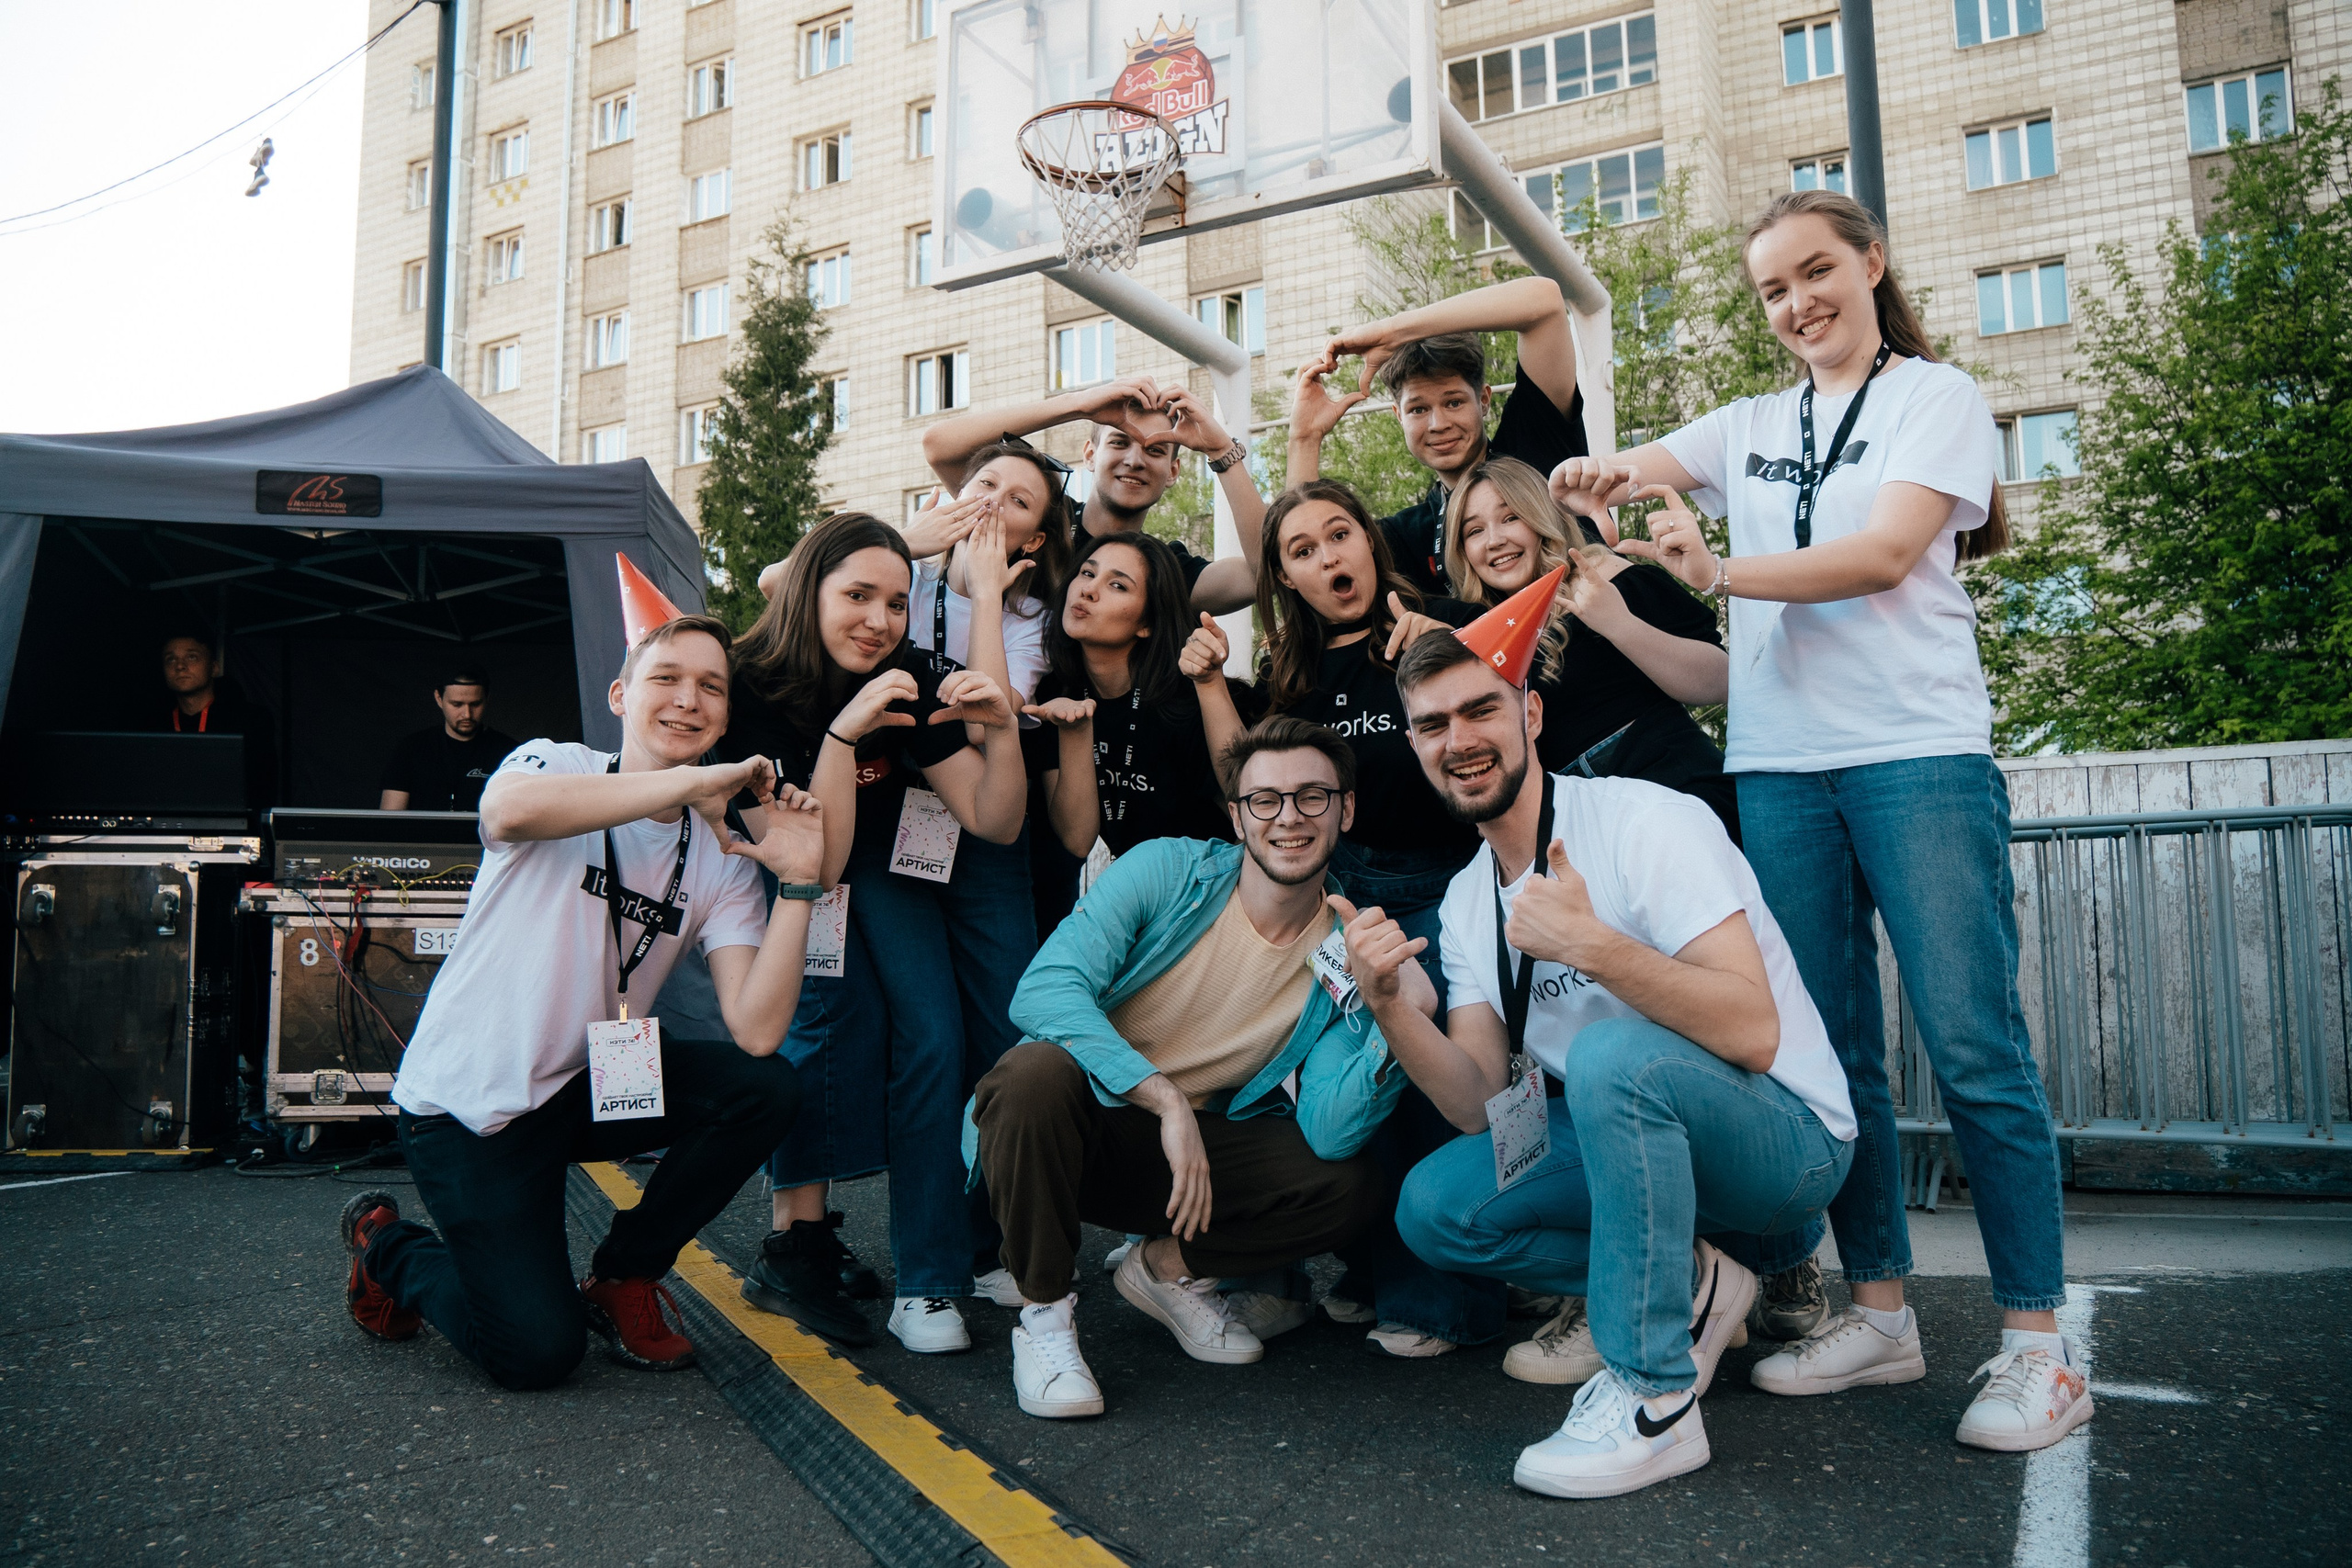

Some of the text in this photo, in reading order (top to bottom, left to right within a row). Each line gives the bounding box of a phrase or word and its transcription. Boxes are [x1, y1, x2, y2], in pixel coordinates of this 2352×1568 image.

[1161, 79, 1208, 116] Bull
[1096, 102, 1227, 173] REIGN
[1802, 397, 1810, 417] NETI
[1757, 462, 1775, 480] It
[1798, 501, 1808, 520] NETI
[1125, 745, 1133, 765] NETI
[1103, 800, 1113, 820] NETI
[1117, 800, 1126, 819] NETI
[682, 820, 690, 842] NETI
[371, 856, 431, 869] DiGiCo
[896, 857, 946, 874] АРТИСТ
[592, 871, 608, 896] It
[668, 879, 679, 901] NETI
[300, 938, 320, 966] 8
[635, 935, 651, 957] NETI
[805, 958, 839, 969] РТИСТ
[1316, 942, 1357, 986] ТИКЕРПАК
[599, 1098, 657, 1112] АРТИСТ
[1503, 1141, 1546, 1181] АРТИСТ
[1032, 1305, 1052, 1315] adidas
